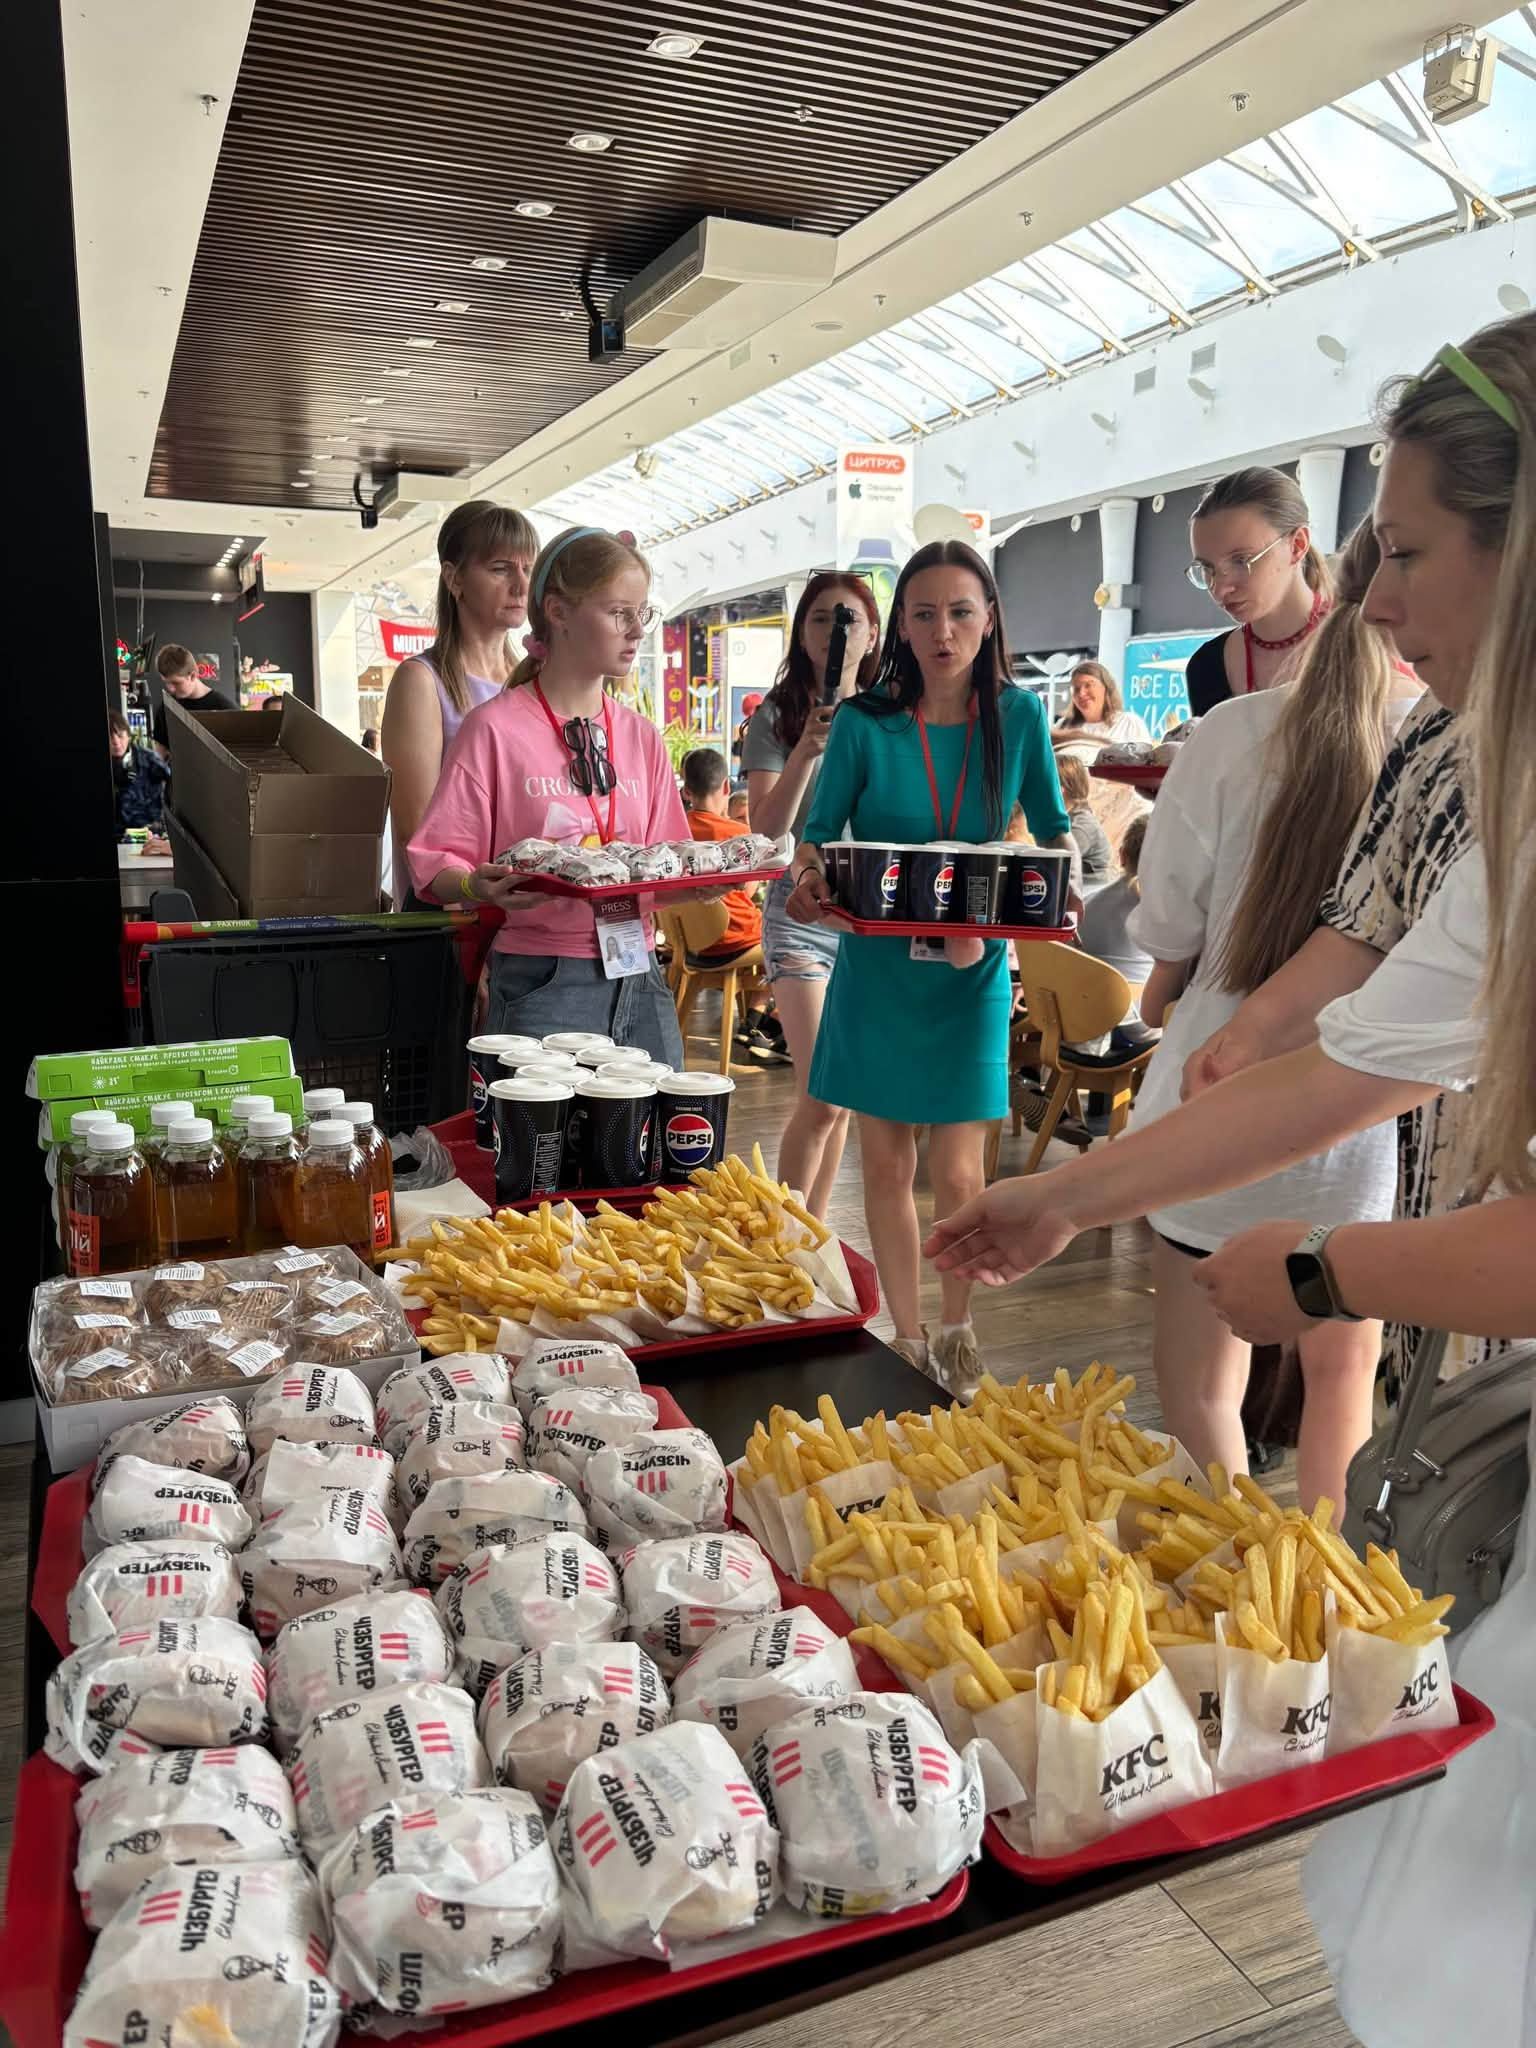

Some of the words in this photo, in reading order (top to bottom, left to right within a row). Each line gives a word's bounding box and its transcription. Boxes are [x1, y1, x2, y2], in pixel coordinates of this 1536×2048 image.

[849, 456, 900, 470] ЦИТРУС
[601, 900, 632, 913] PRESS
[667, 1131, 712, 1145] PEPSI
[305, 1368, 327, 1412] ЧІЗБУРГЕР
[623, 1454, 692, 1473] ЧІЗБУРГЕ
[118, 1560, 212, 1576] ЧІЗБУРГЕР
[353, 1615, 377, 1691] ЧІЗБУРГЕР
[1393, 1661, 1438, 1710] KFC
[813, 1707, 826, 1728] KFC
[1280, 1693, 1331, 1736] KFC
[384, 1703, 425, 1784] ЧІЗБУРГЕР
[1099, 1733, 1168, 1796] KFC
[886, 1717, 918, 1814] ЧІЗБУРГЕР
[598, 1774, 657, 1868] ЧІЗБУРГЕР
[719, 1831, 738, 1868] KFC
[179, 1868, 220, 1953] ЧІЗБУРГЕ
